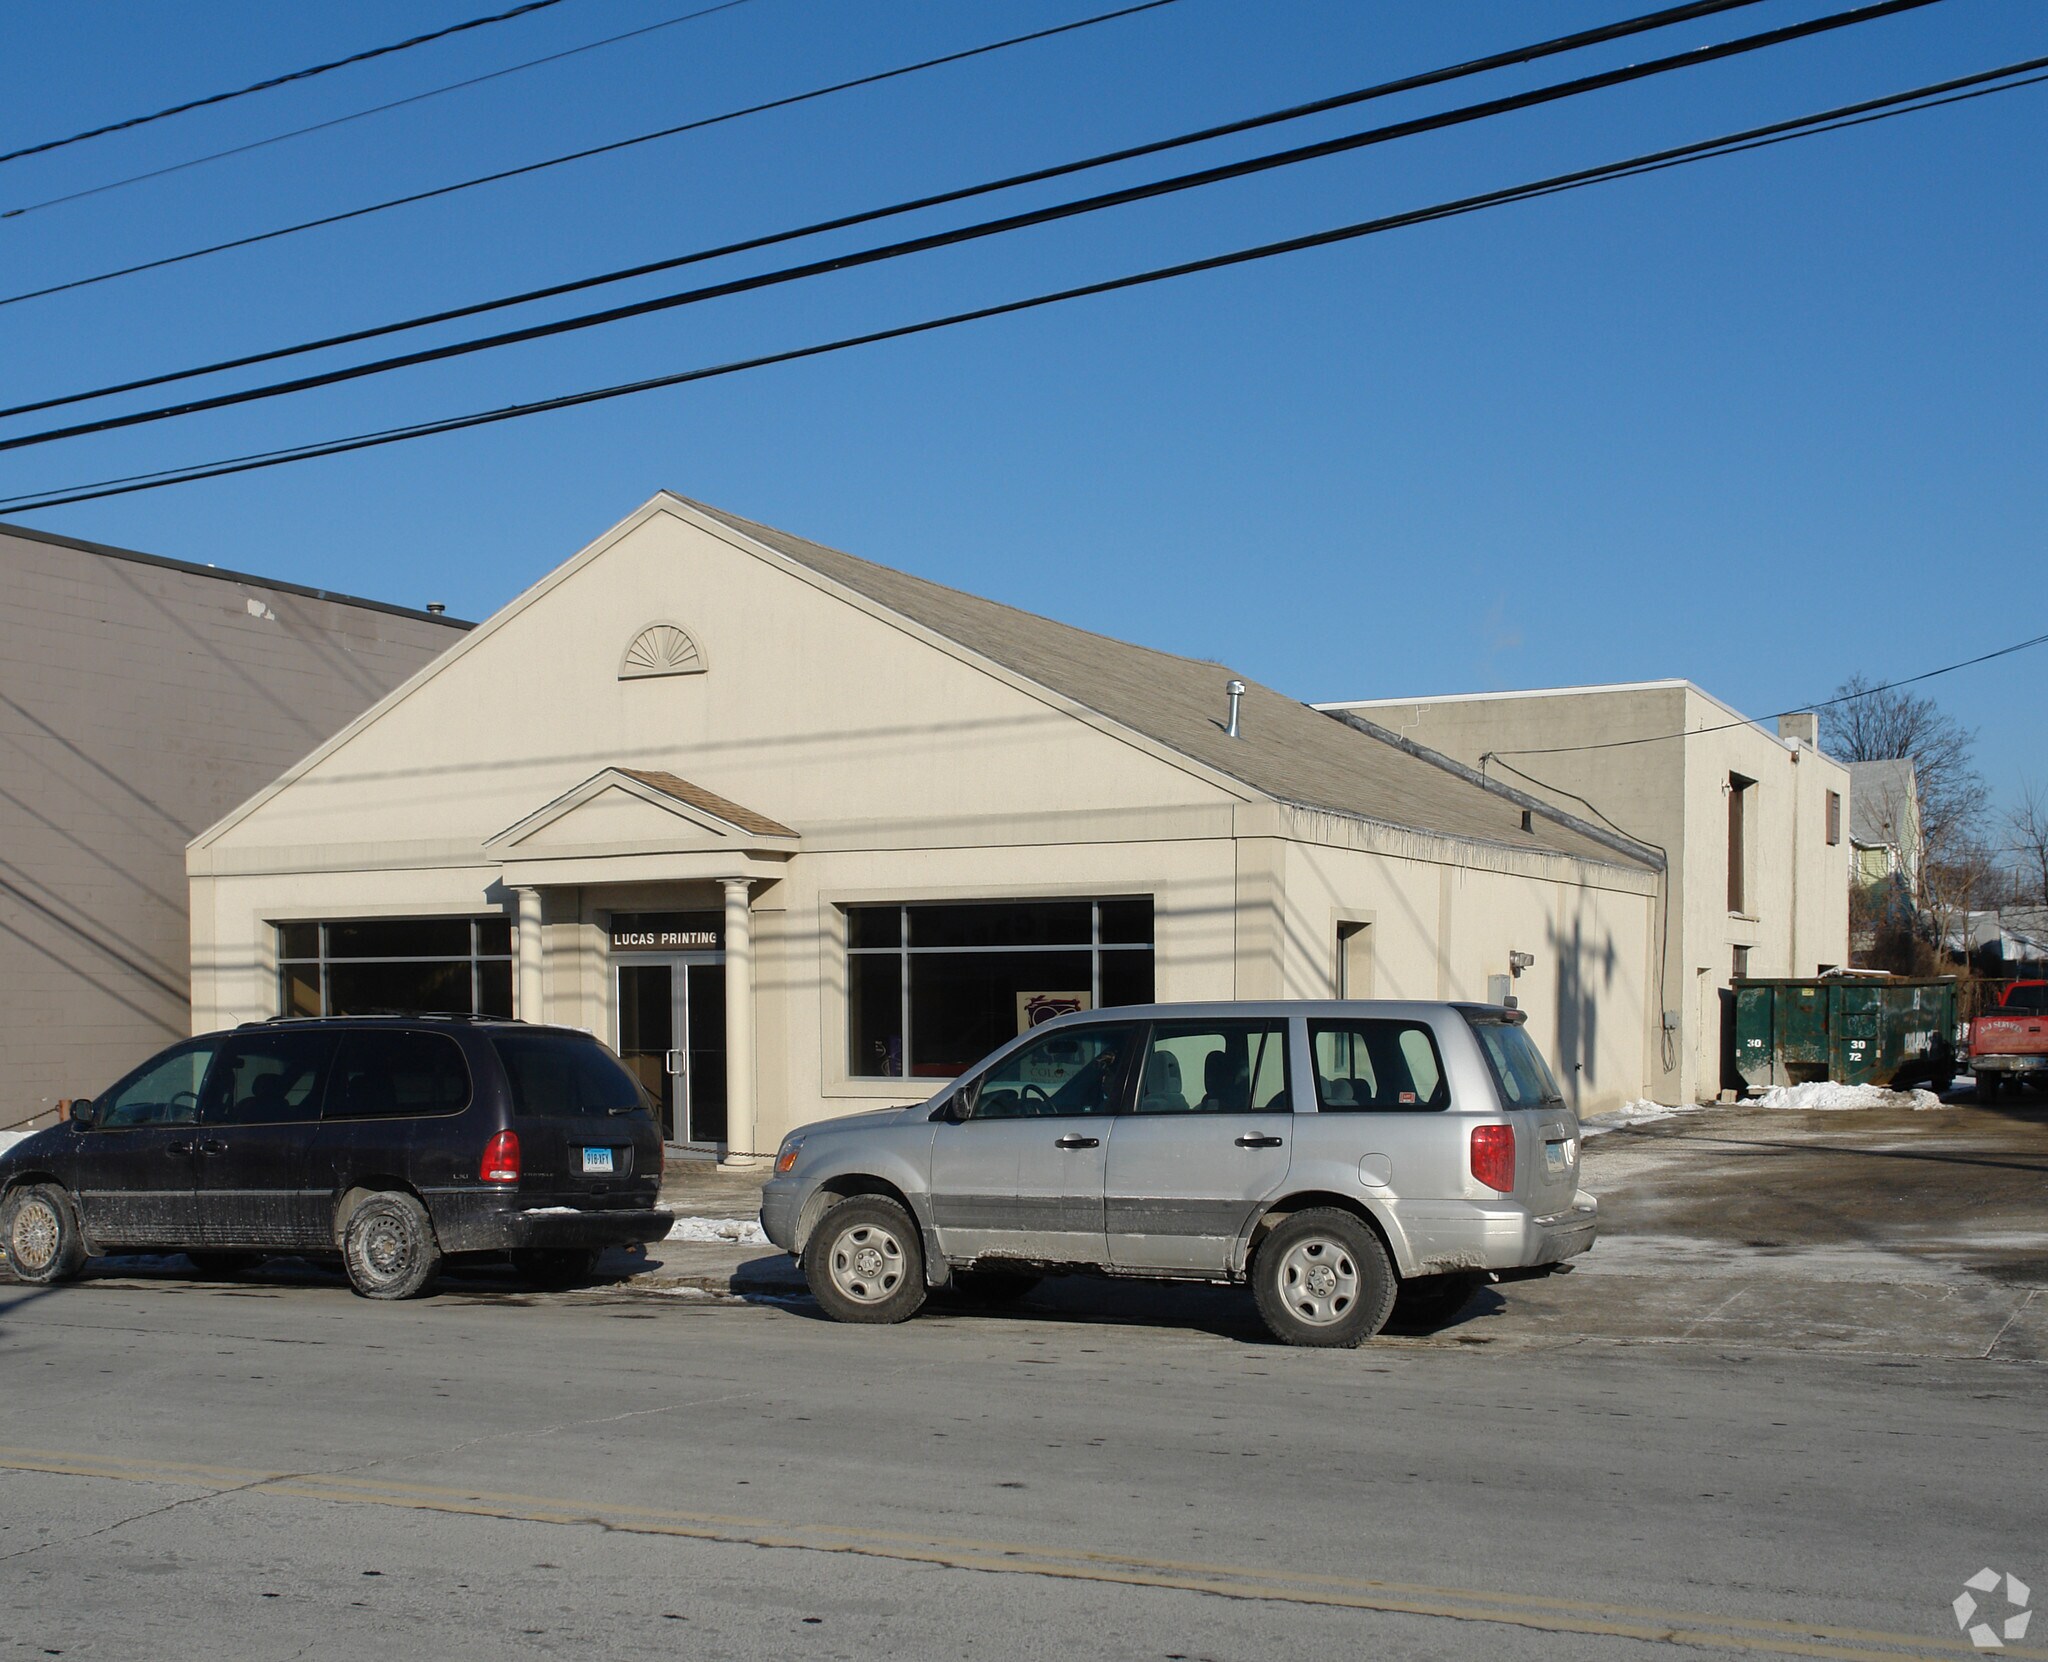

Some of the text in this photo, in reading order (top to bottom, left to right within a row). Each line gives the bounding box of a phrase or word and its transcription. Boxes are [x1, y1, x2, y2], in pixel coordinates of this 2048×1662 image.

[614, 931, 717, 946] LUCAS PRINTING
[1746, 1038, 1762, 1048] 30
[1850, 1040, 1866, 1049] 30
[1848, 1052, 1862, 1062] 72
